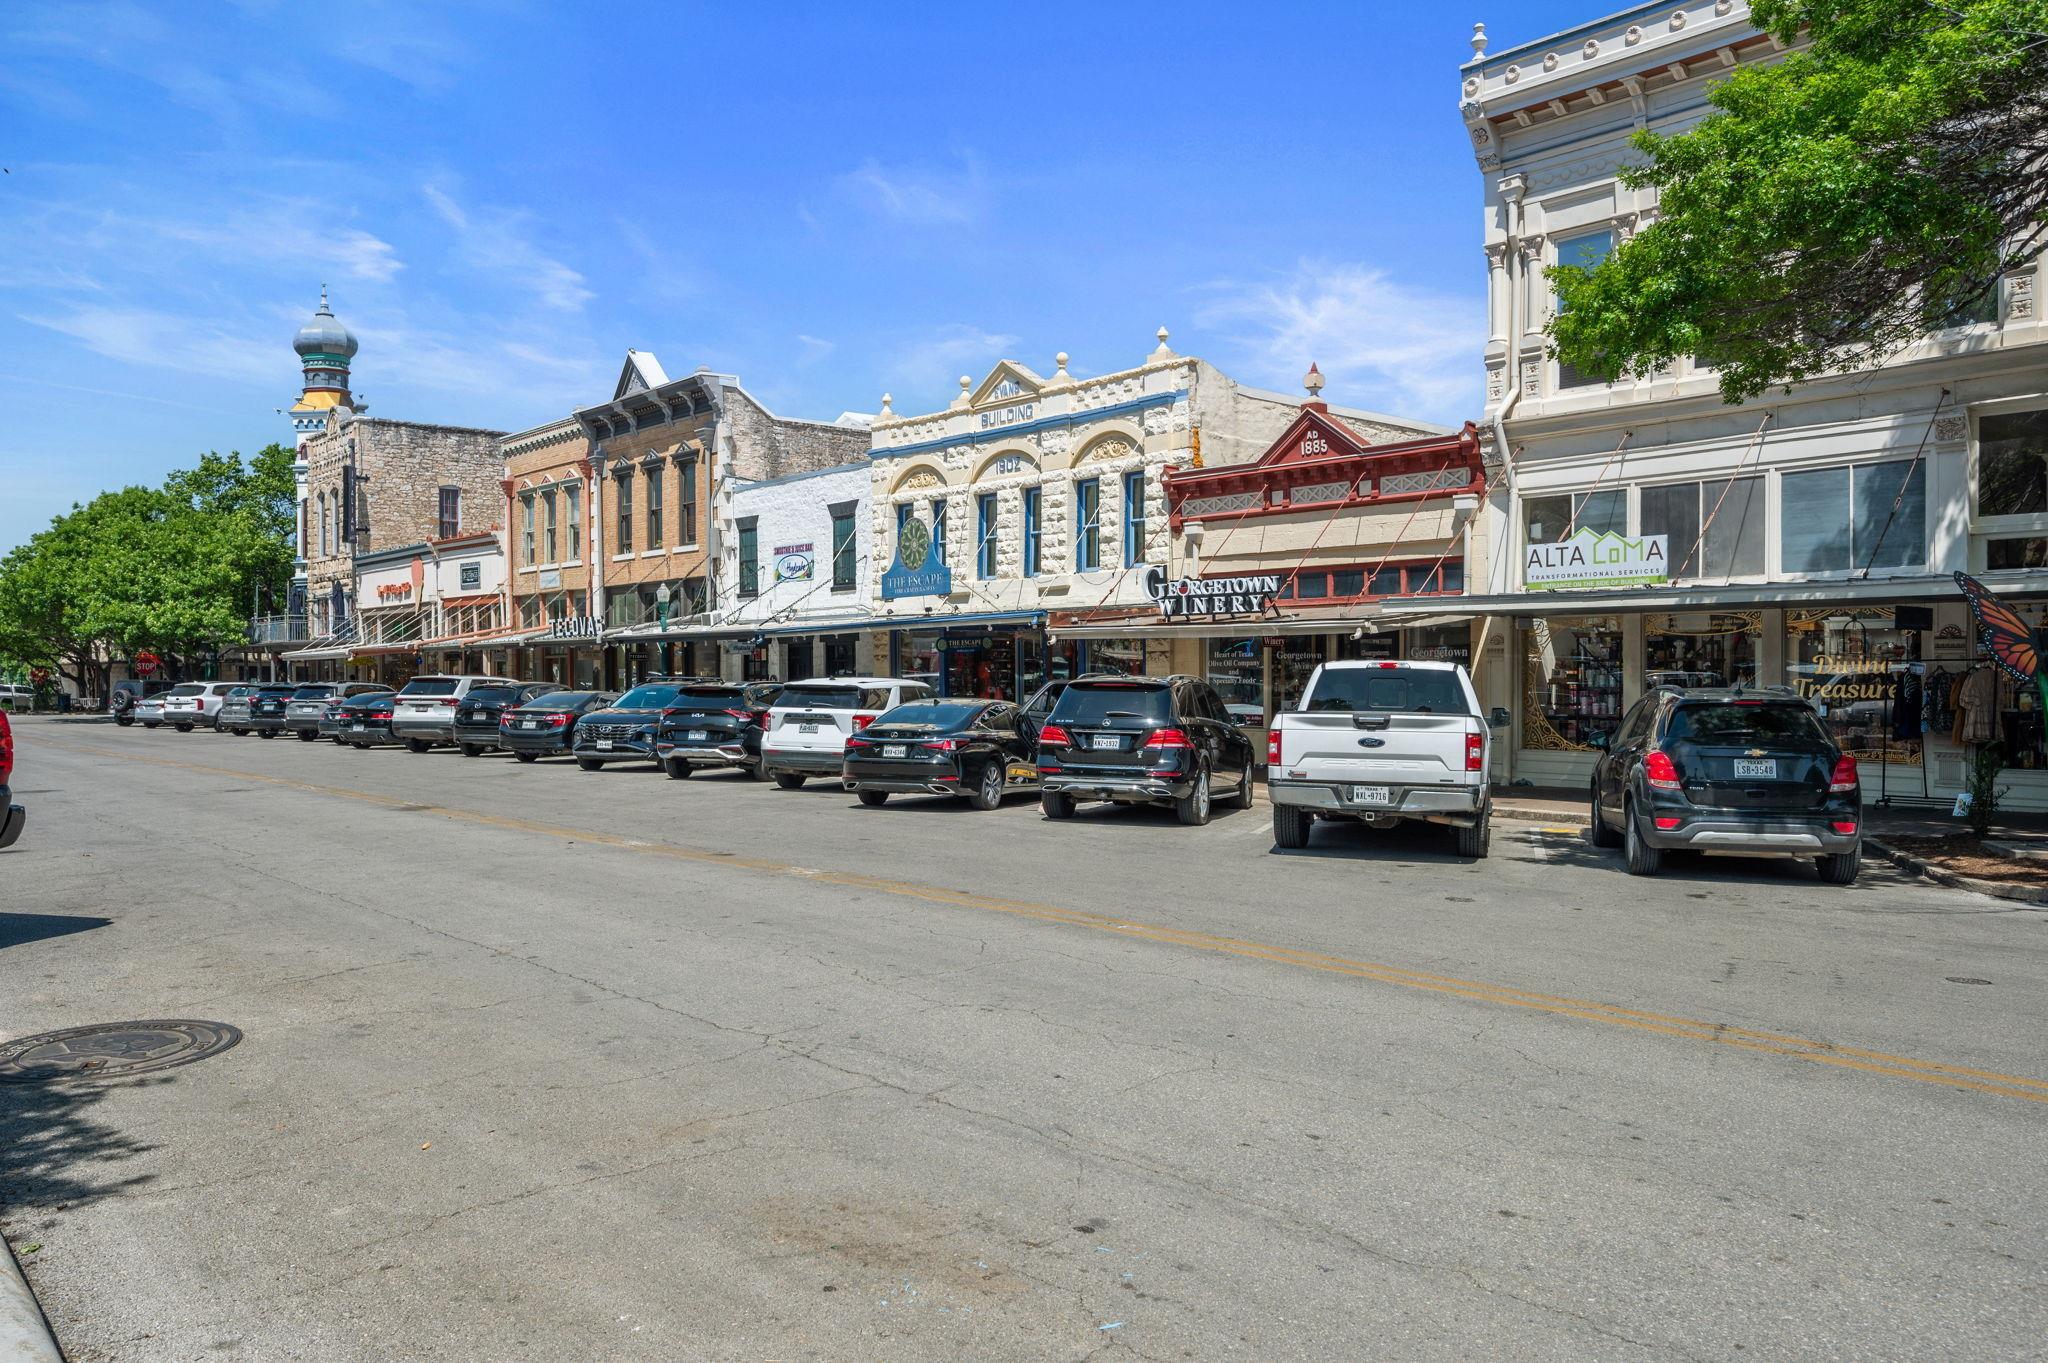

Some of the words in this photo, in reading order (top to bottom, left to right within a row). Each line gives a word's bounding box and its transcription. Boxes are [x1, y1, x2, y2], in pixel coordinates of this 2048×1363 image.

[995, 383, 1020, 399] EVANS
[981, 403, 1033, 429] BUILDING
[1306, 430, 1319, 440] AD
[1300, 439, 1328, 456] 1885
[996, 456, 1021, 475] 1902
[1527, 545, 1585, 569] ALTA
[887, 576, 906, 588] THE
[908, 572, 943, 587] ESCAPE
[1531, 571, 1614, 580] TRANSFORMATIONAL
[1618, 568, 1661, 576] SERVICES
[1621, 577, 1650, 585] BUILDING
[1157, 594, 1263, 615] WINERY
[1263, 637, 1285, 645] Winery
[1276, 651, 1322, 660] Georgetown
[1411, 646, 1468, 658] Georgetown
[137, 663, 155, 671] STOP
[1233, 660, 1260, 669] Company
